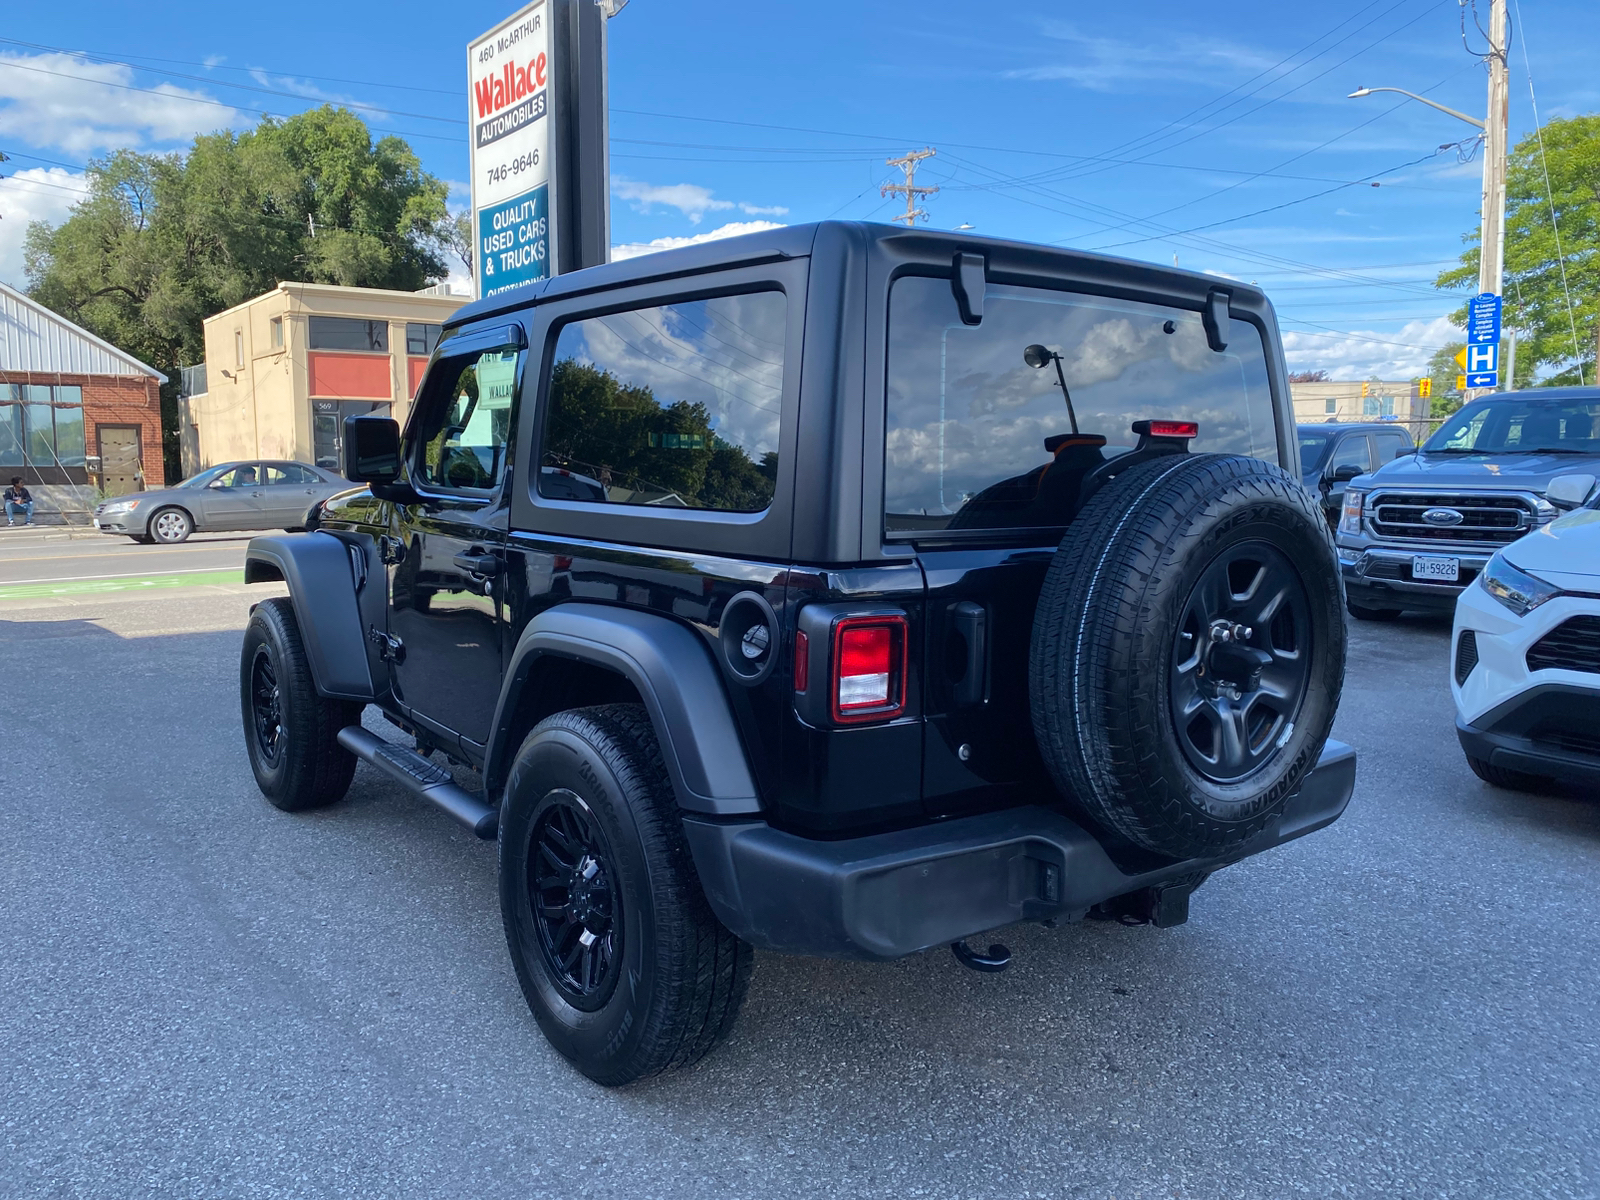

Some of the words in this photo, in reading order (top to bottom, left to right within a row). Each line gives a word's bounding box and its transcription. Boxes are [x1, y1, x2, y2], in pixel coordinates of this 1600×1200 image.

[479, 45, 494, 63] 460
[497, 14, 541, 53] McARTHUR
[475, 52, 546, 118] Wallace
[481, 95, 544, 142] AUTOMOBILES
[487, 148, 539, 185] 746-9646
[493, 198, 537, 230] QUALITY
[484, 230, 514, 254] USED
[519, 217, 546, 243] CARS
[485, 257, 494, 275] &
[500, 240, 546, 272] TRUCKS
[1471, 346, 1494, 371] H
[319, 402, 332, 410] 569
[1415, 562, 1426, 573] CH
[1430, 563, 1457, 575] 59226
[1239, 749, 1308, 817] ROADIAN
